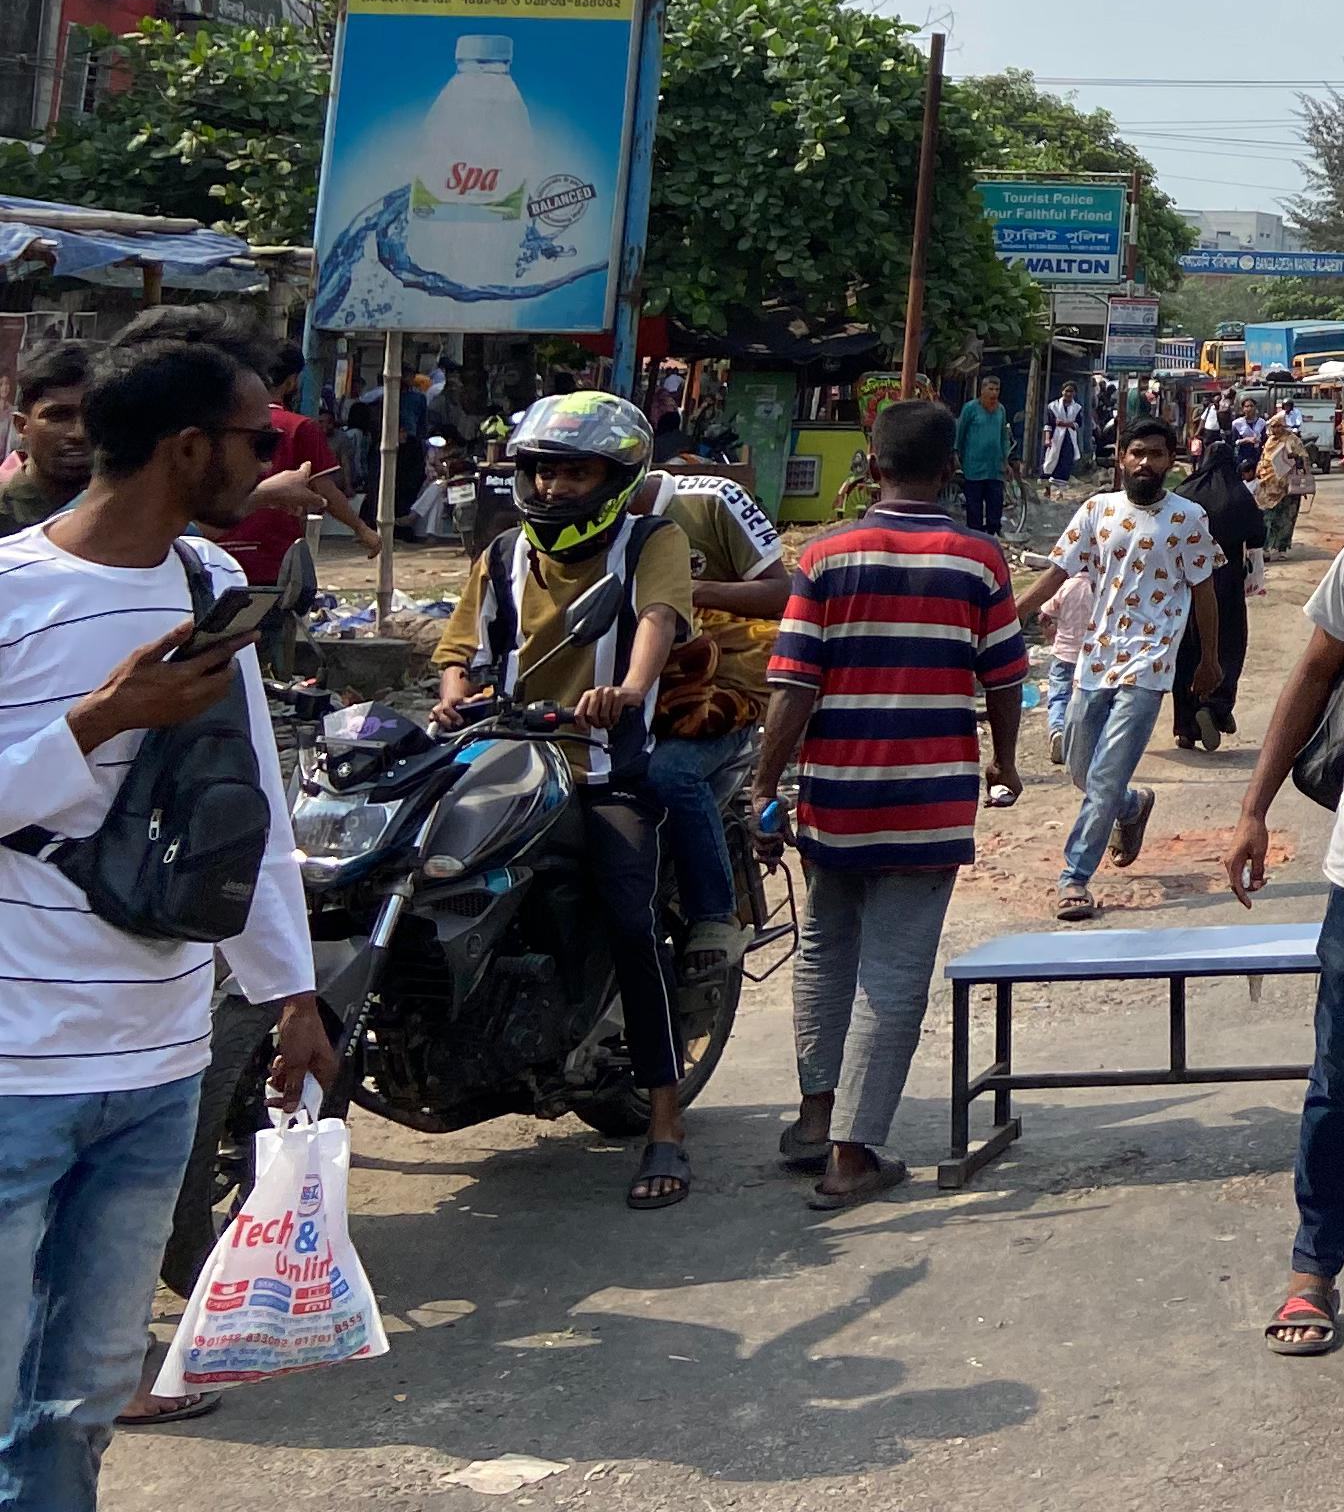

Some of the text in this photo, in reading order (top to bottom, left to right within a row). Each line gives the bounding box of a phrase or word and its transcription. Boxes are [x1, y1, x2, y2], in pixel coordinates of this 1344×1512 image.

[447, 162, 500, 195] Spa
[530, 186, 593, 215] BALANCED
[1002, 192, 1094, 205] Tourist Police
[1016, 208, 1066, 220] Faithful
[1069, 209, 1113, 221] Friend
[1024, 258, 1110, 274] WALTON
[231, 1209, 320, 1254] Tech &
